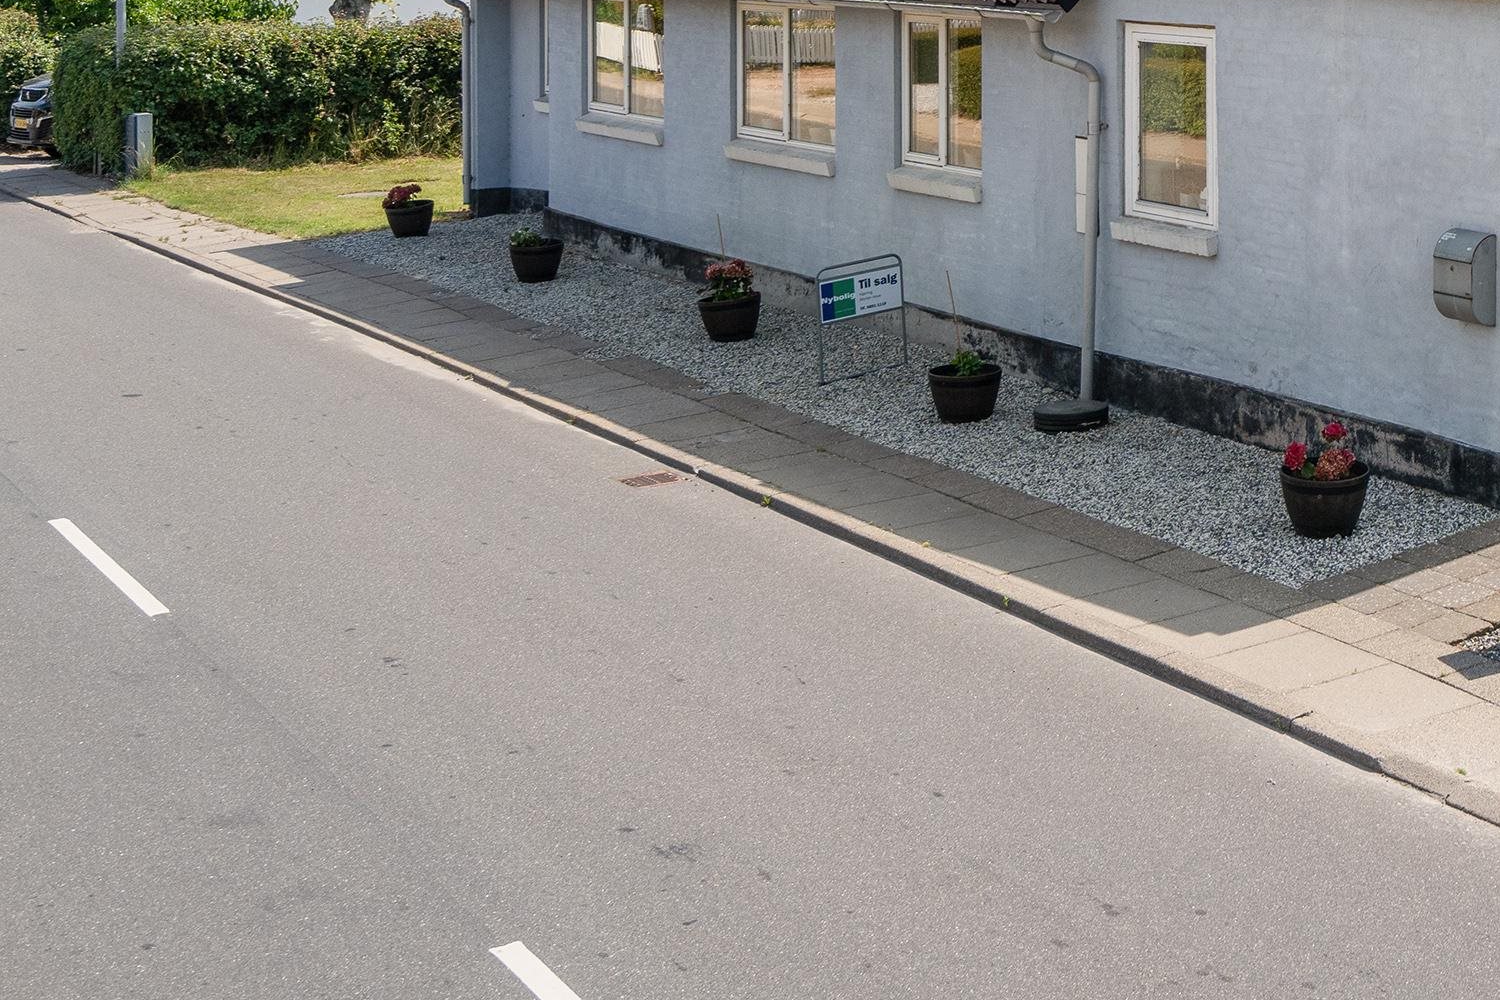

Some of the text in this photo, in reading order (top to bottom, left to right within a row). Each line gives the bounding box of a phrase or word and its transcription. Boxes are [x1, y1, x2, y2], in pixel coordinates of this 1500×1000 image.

[858, 273, 897, 289] Til salg
[822, 292, 856, 304] Nybolig
